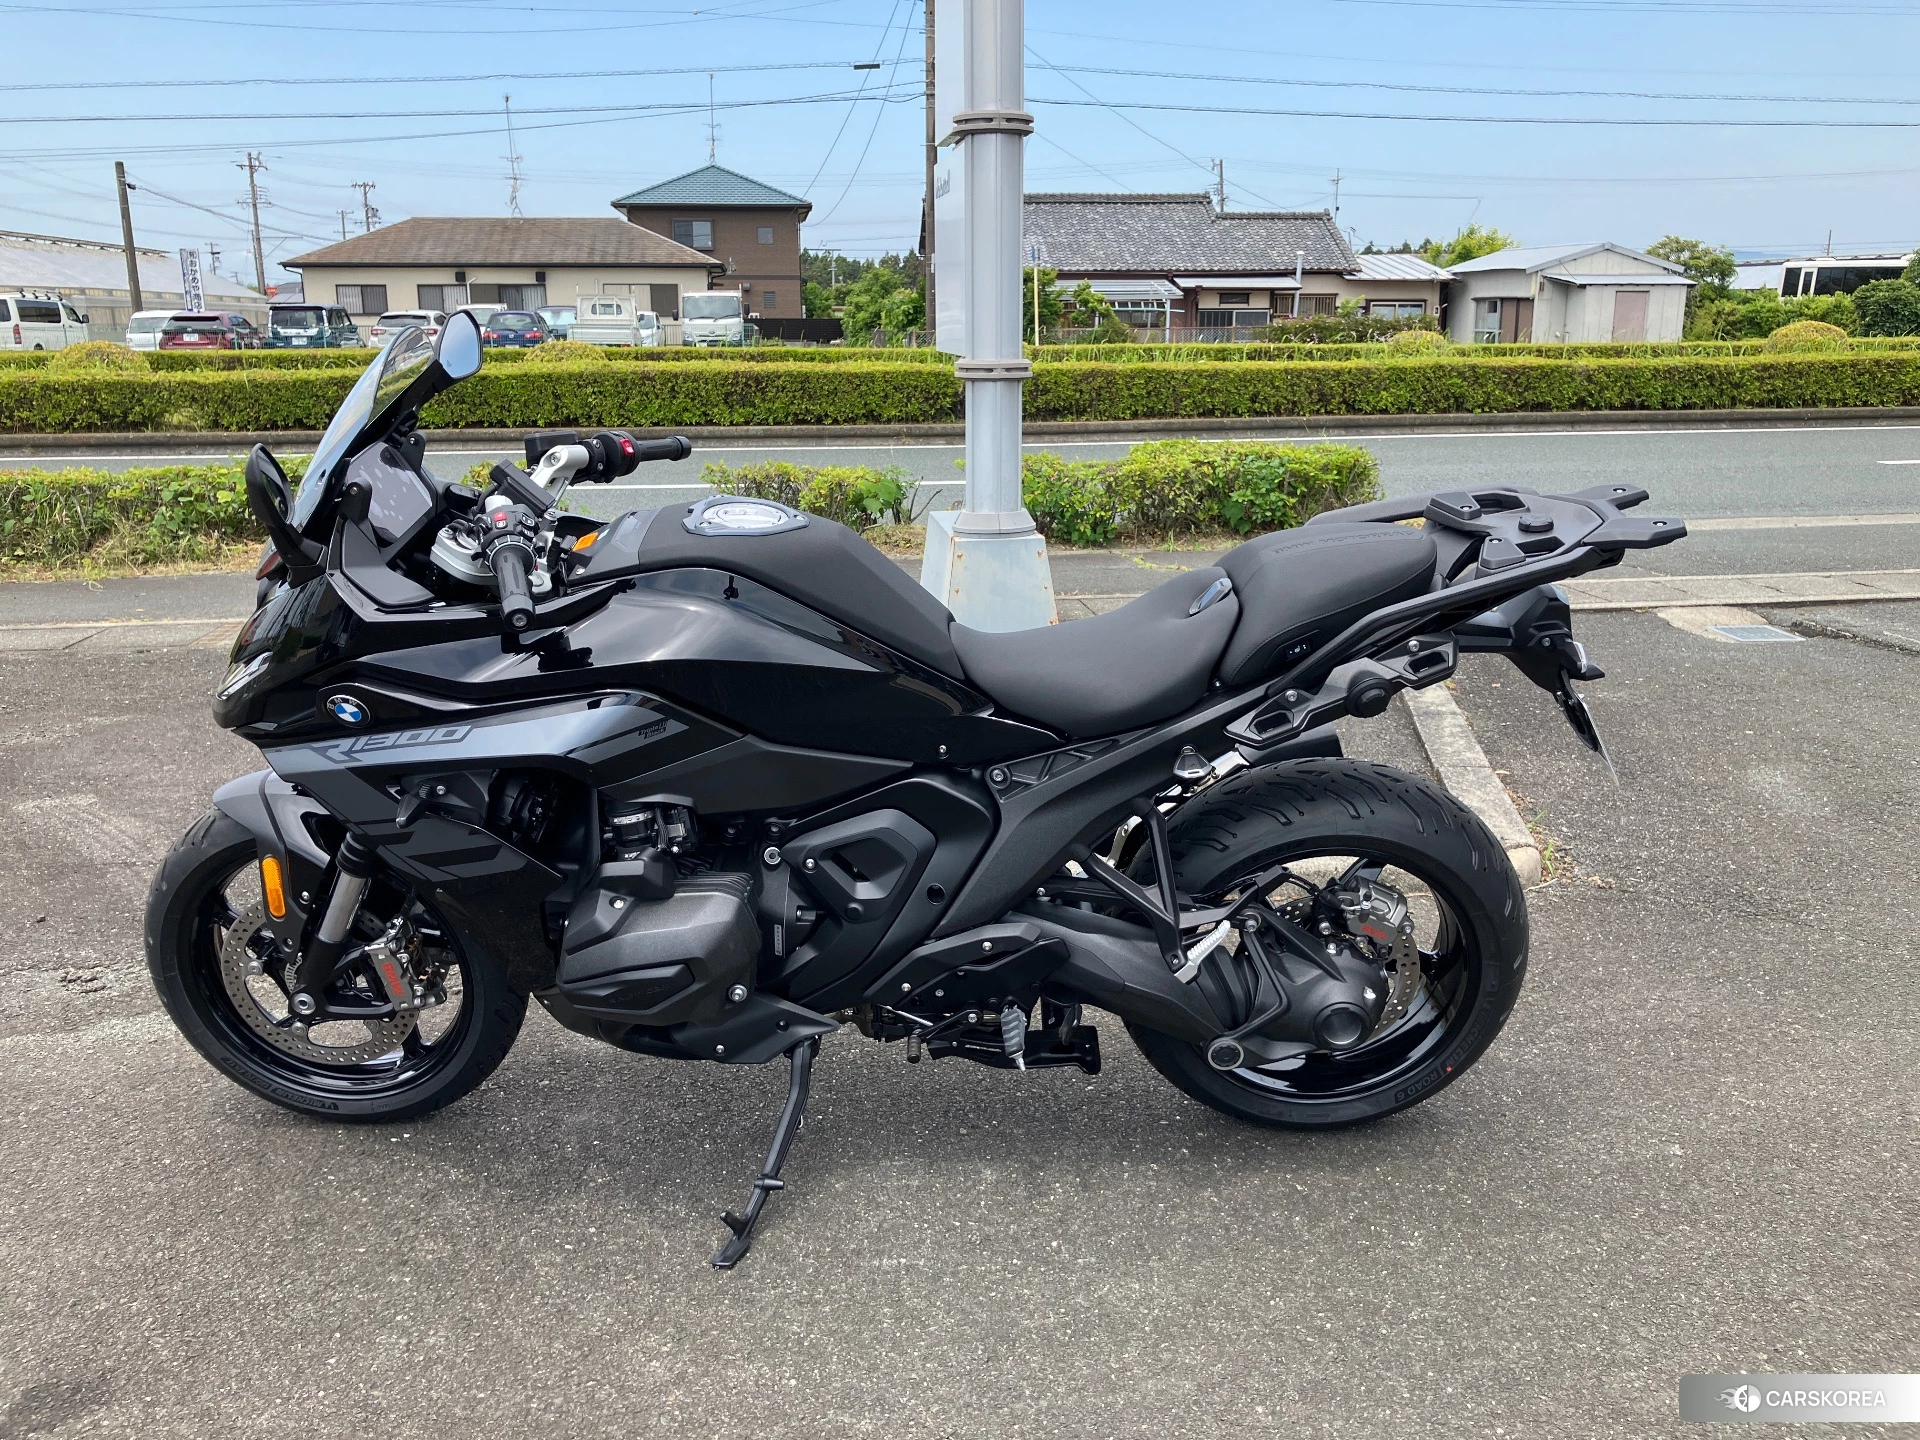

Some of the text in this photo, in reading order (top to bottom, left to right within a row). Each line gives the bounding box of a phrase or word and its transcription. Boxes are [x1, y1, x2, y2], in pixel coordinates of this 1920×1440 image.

[327, 697, 358, 710] BMW
[311, 725, 472, 763] R1300
[382, 962, 405, 996] BMW
[1396, 1066, 1440, 1100] ROAD 6
